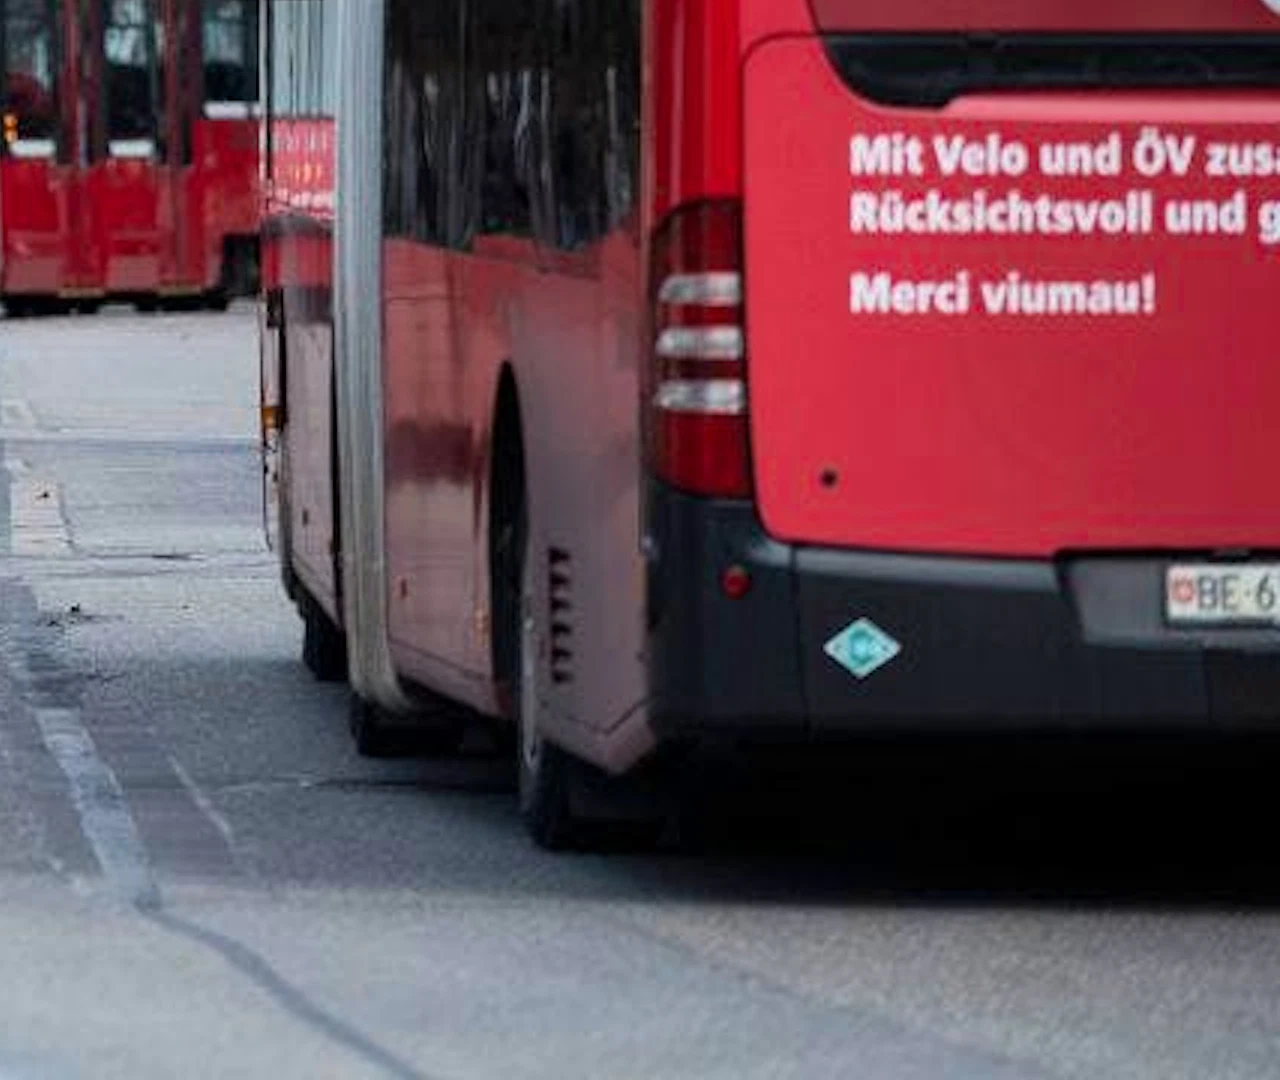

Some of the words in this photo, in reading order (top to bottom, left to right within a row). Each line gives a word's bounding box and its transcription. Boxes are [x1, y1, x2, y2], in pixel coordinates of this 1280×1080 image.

[850, 133, 924, 176] Mit
[934, 132, 1028, 176] Velo
[1039, 132, 1123, 176] und
[1134, 126, 1195, 176] ÖV
[850, 190, 1153, 234] Rücksichtsvoll
[1165, 190, 1247, 234] und
[850, 271, 970, 314] Merci
[980, 270, 1156, 314] viumau!
